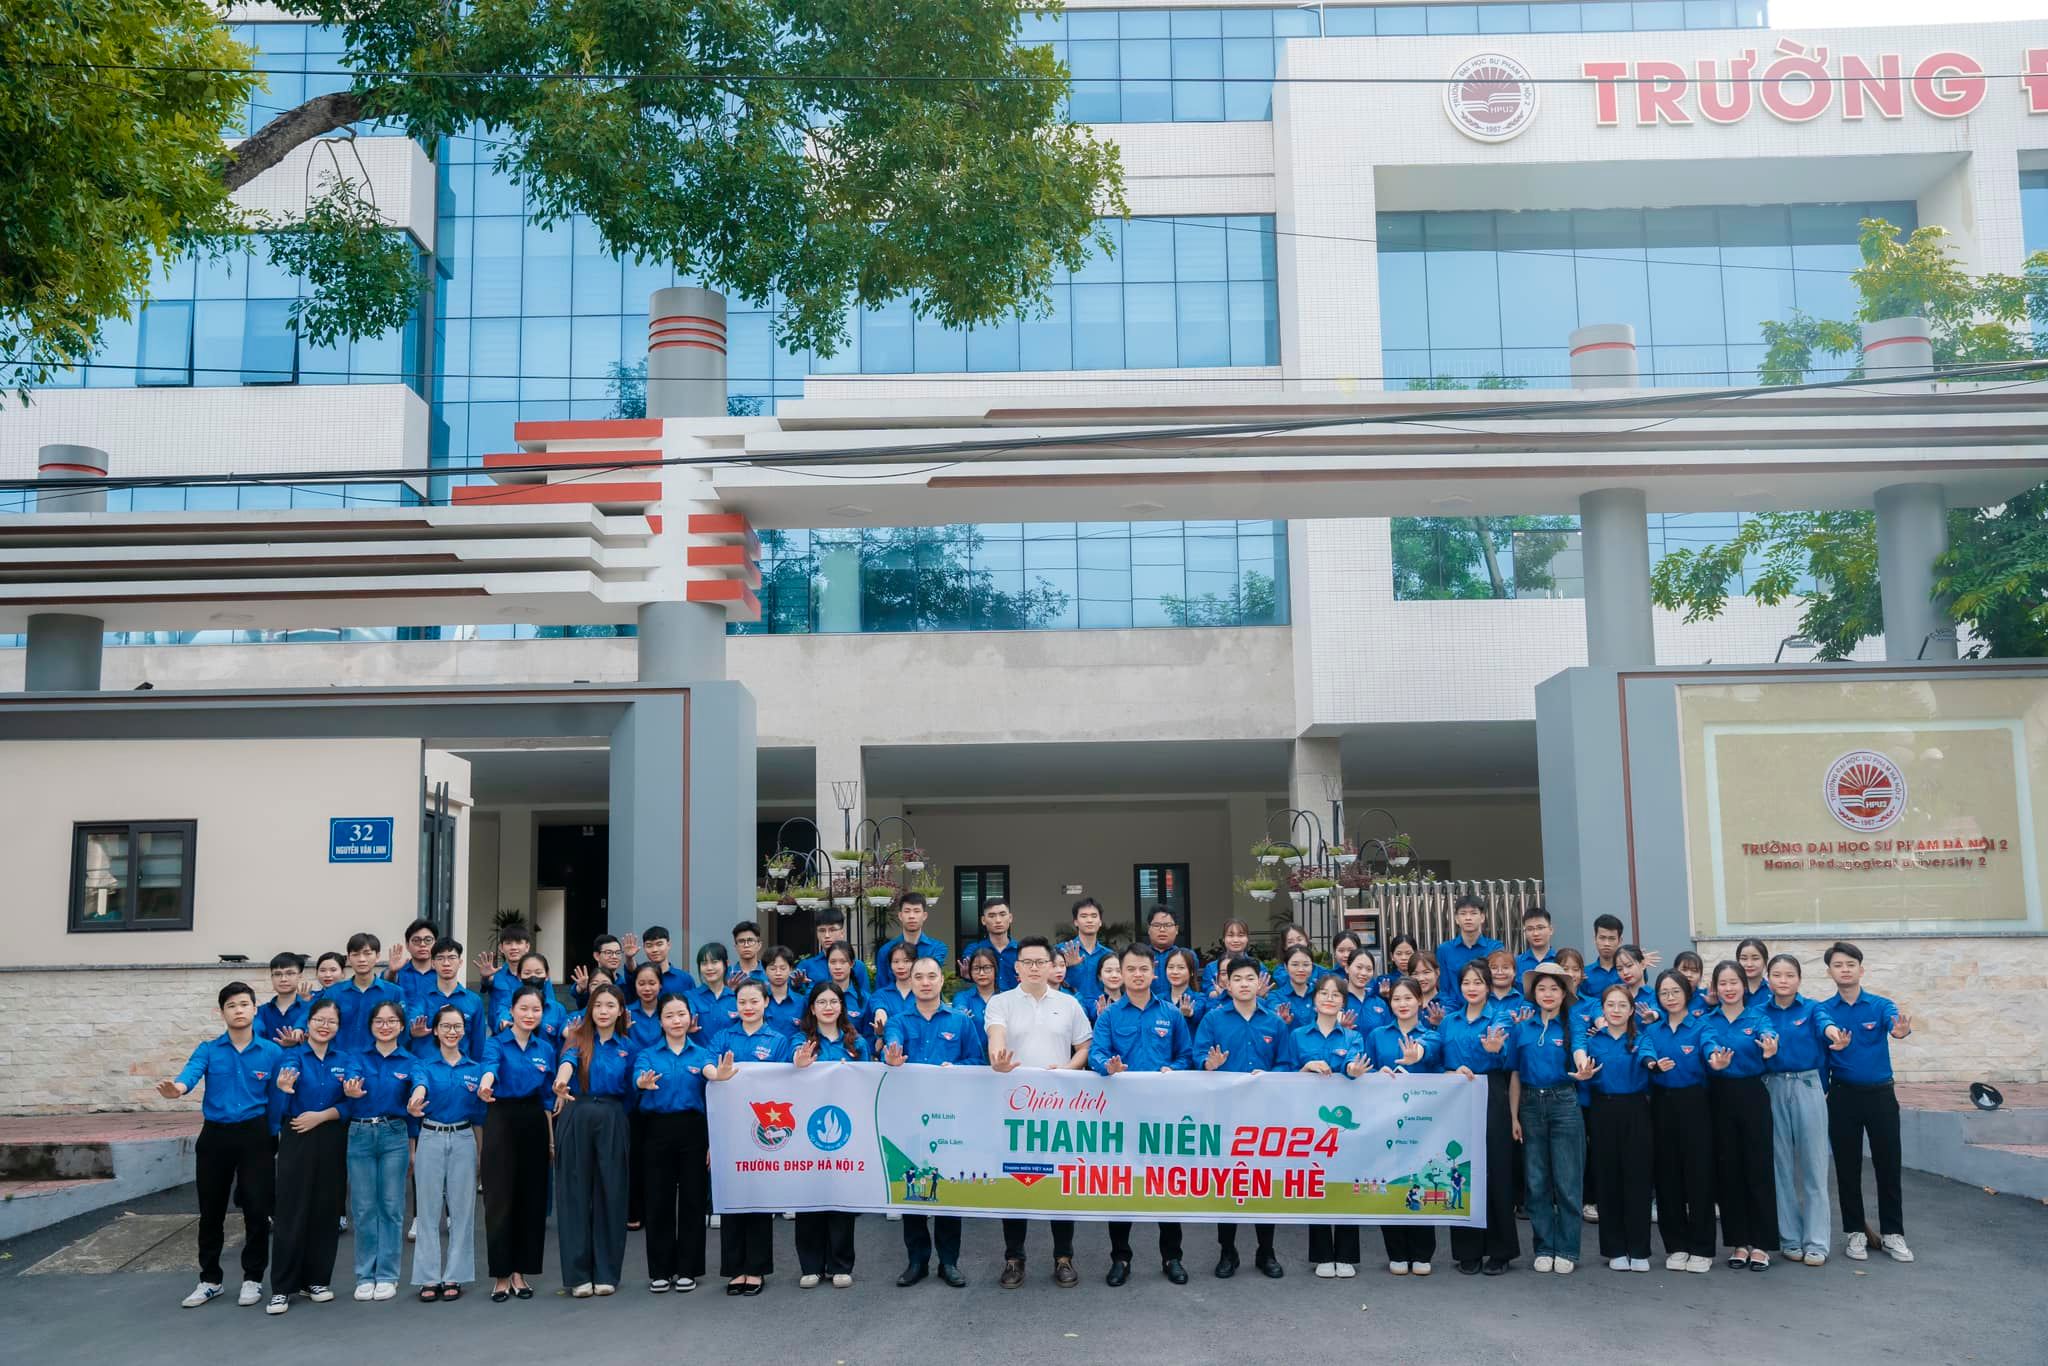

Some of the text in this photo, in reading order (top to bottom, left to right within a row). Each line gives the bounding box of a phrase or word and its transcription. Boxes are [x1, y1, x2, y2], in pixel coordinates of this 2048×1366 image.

[1582, 37, 1987, 126] TRƯỜNG
[349, 824, 374, 841] 32
[1838, 840, 1871, 855] HỌC
[2000, 839, 2008, 850] 2
[1978, 857, 1987, 866] 2
[1009, 1085, 1108, 1116] Chiến dịch
[1004, 1115, 1339, 1158] THANH NIÊN 2024
[736, 1157, 865, 1173] TRƯỜNG ĐHSP HÀ NỘI 2
[1058, 1157, 1326, 1204] TÌNH NGUYỆN HÈ
